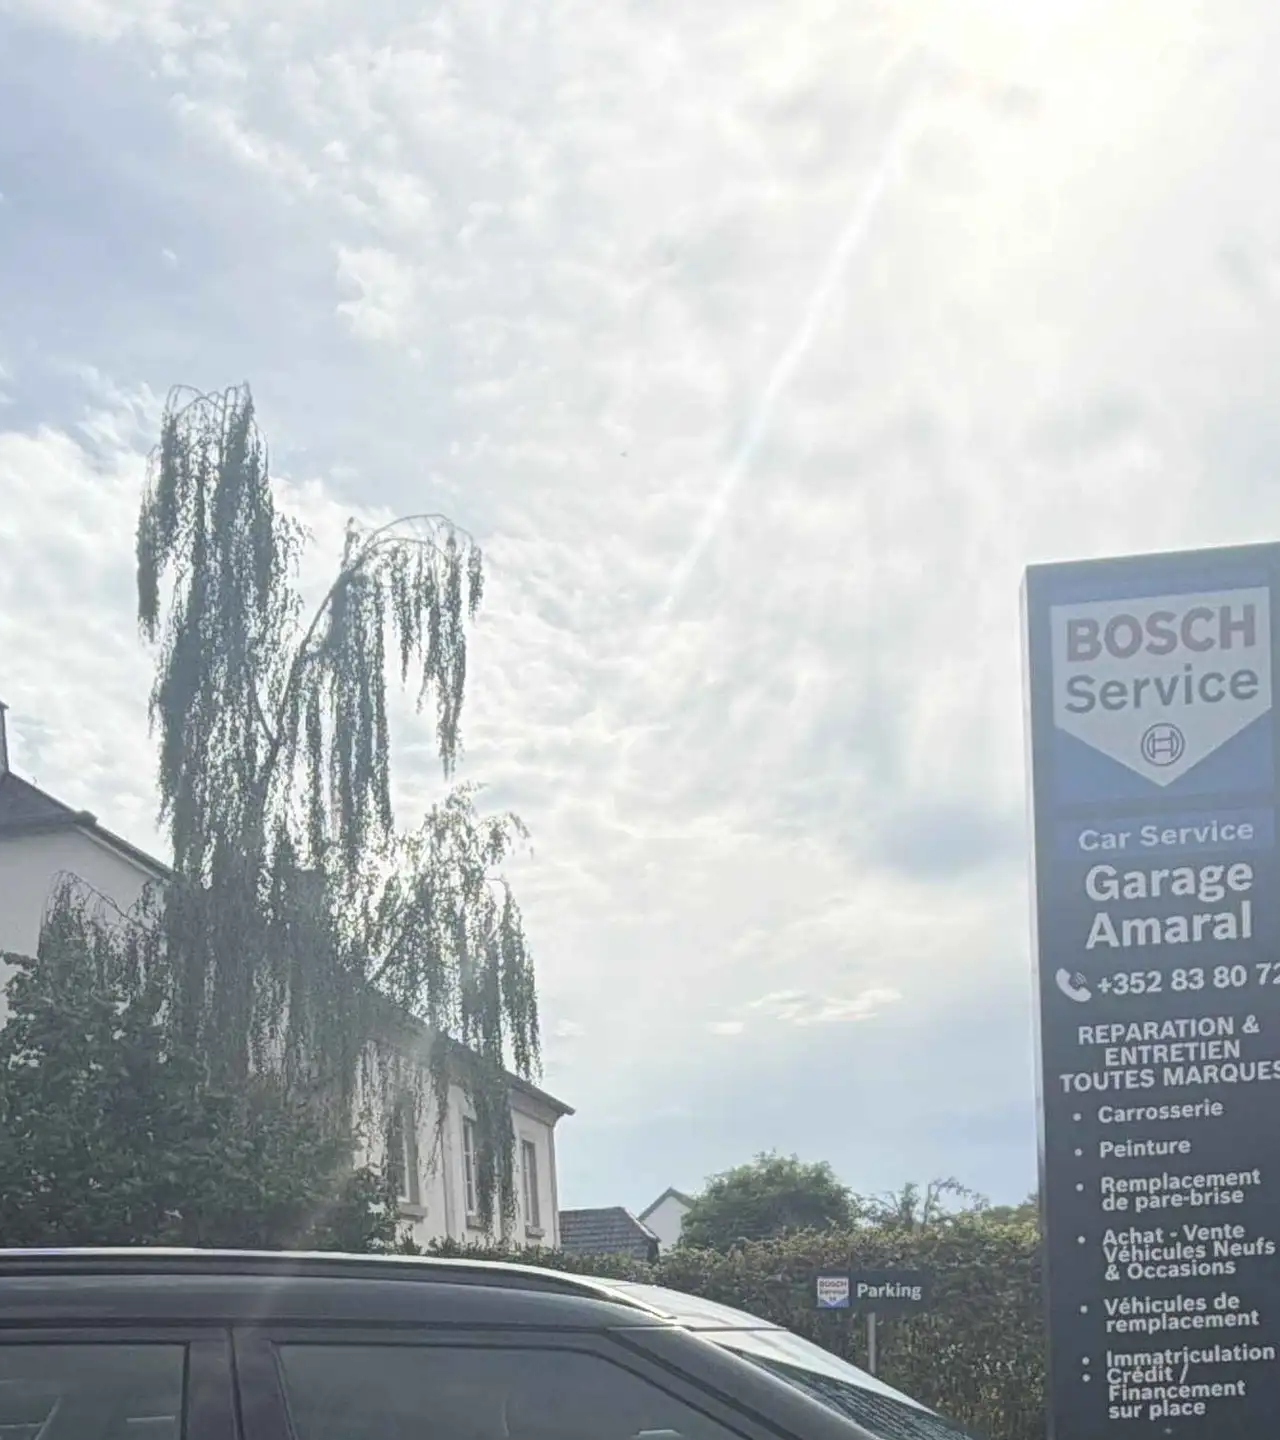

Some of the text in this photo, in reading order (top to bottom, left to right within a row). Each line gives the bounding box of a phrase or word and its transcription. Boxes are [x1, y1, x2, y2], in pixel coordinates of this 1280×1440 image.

[1066, 604, 1256, 663] BOSCH
[1064, 663, 1259, 714] Service
[1078, 820, 1254, 851] Car Service
[1085, 863, 1254, 902] Garage
[1085, 900, 1252, 949] Amaral
[1097, 970, 1163, 995] +352
[1171, 967, 1205, 991] 83
[1213, 965, 1247, 988] 80
[1078, 1014, 1260, 1045] REPARATION &
[1105, 1039, 1241, 1067] ENTRETIEN
[1059, 1069, 1155, 1093] TOUTES
[1098, 1099, 1224, 1123] Carrosserie
[1099, 1139, 1191, 1158] Peinture
[1101, 1168, 1261, 1196] Remplacement
[1102, 1188, 1244, 1213] de pare-brise
[1103, 1226, 1164, 1246] Achat
[1183, 1223, 1245, 1241] Vente
[1104, 1237, 1276, 1263] Véhicules Neufs
[1105, 1259, 1236, 1281] & Occasions
[857, 1282, 922, 1300] Parking
[1104, 1292, 1240, 1316] Véhicules de
[1106, 1310, 1260, 1334] remplacement
[1106, 1344, 1276, 1367] Immatriculation
[1107, 1362, 1189, 1384] Crédit /
[1109, 1380, 1246, 1402] Financement
[1109, 1400, 1206, 1421] sur place
